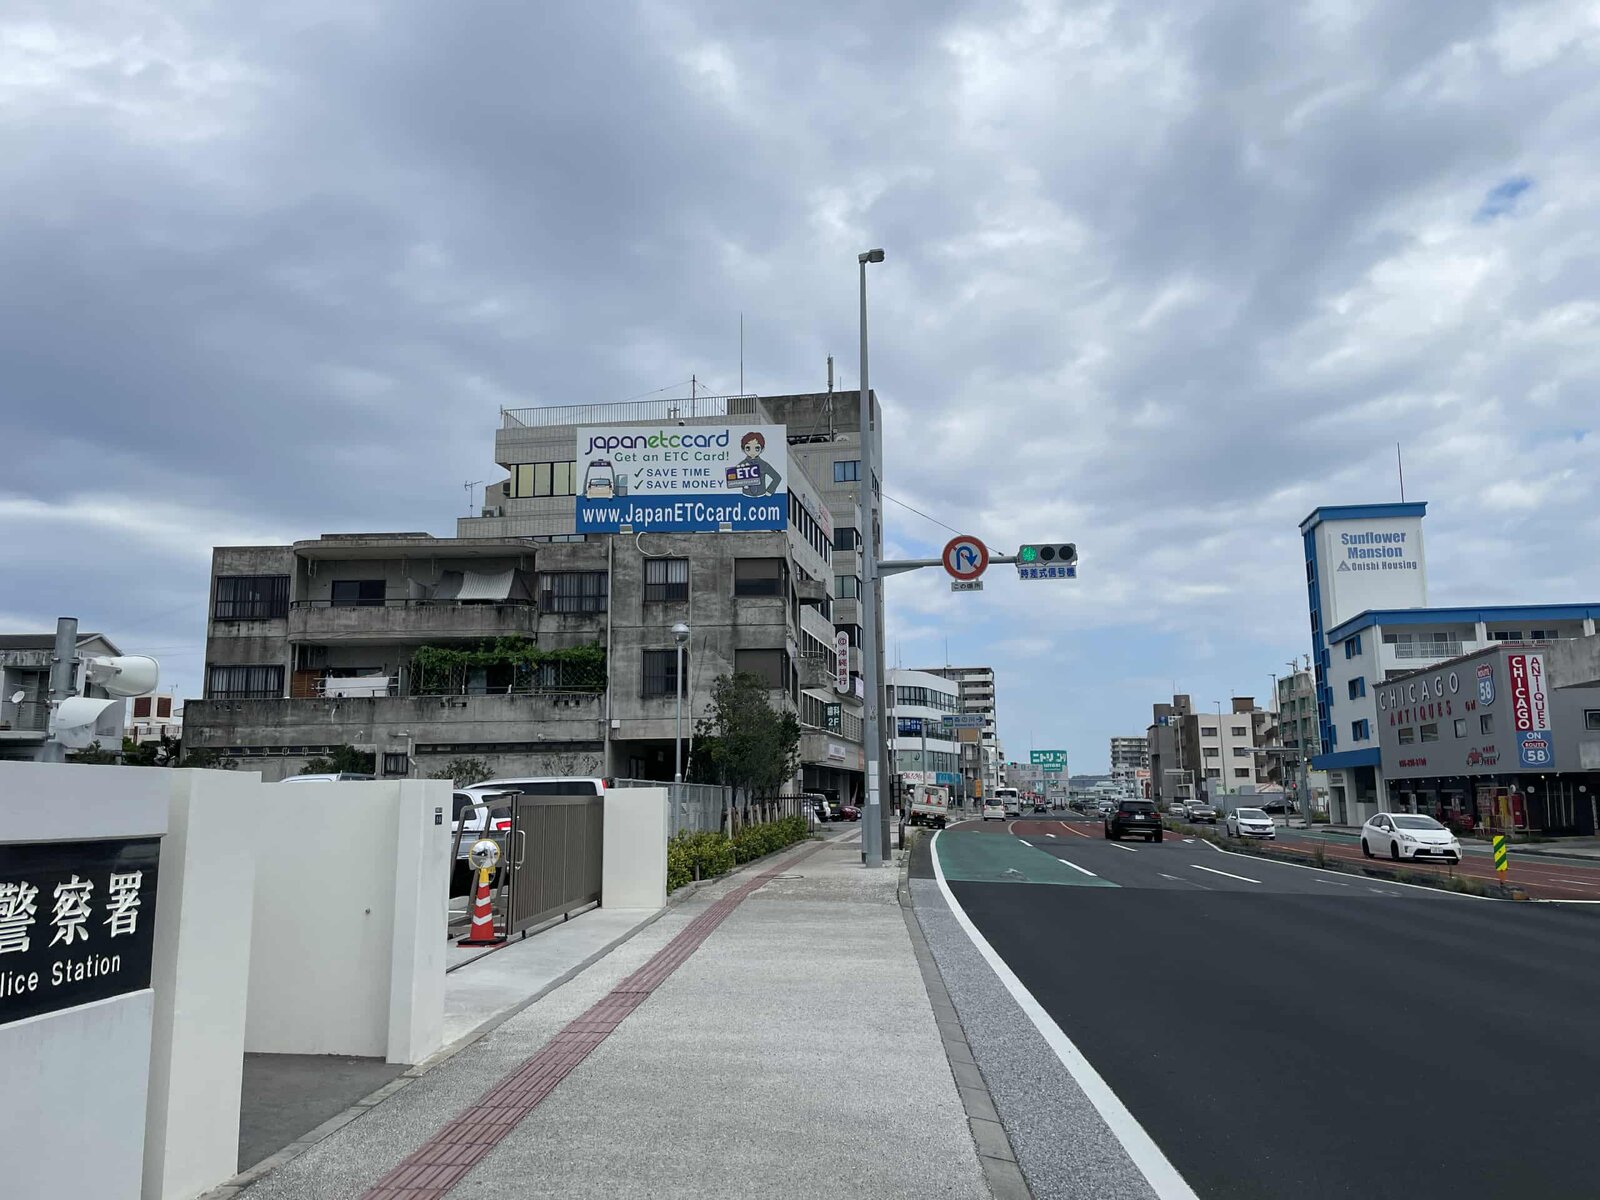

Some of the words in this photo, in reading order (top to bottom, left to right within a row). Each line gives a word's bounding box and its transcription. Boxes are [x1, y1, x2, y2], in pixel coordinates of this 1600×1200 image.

[585, 430, 729, 455] japanetccard
[614, 452, 637, 462] Get
[643, 453, 659, 462] an
[665, 451, 689, 461] ETC
[694, 451, 729, 461] Card!
[646, 468, 678, 477] SAVE
[682, 468, 710, 477] TIME
[736, 466, 759, 479] ETC
[646, 480, 678, 489] SAVE
[682, 480, 724, 489] MONEY
[582, 502, 780, 527] www.JapanETCcard.com
[1341, 532, 1406, 545] Sunflower
[1347, 546, 1403, 559] Mansion
[1351, 561, 1380, 571] Onishi
[1381, 560, 1417, 570] Housing
[1020, 567, 1077, 579] 時差式信号機
[1380, 672, 1460, 710] CHICAGO
[1479, 681, 1492, 700] 58
[1511, 656, 1530, 729] CHICAGO
[1530, 656, 1546, 729] ANTIQUES
[827, 706, 840, 717] 歯科
[1390, 700, 1452, 726] ANTIQUES
[828, 717, 839, 727] 2F
[1526, 732, 1541, 740] ON
[1527, 750, 1546, 761] 58
[0, 870, 143, 954] 警察署
[0, 971, 39, 998] lice
[51, 954, 121, 986] Station
